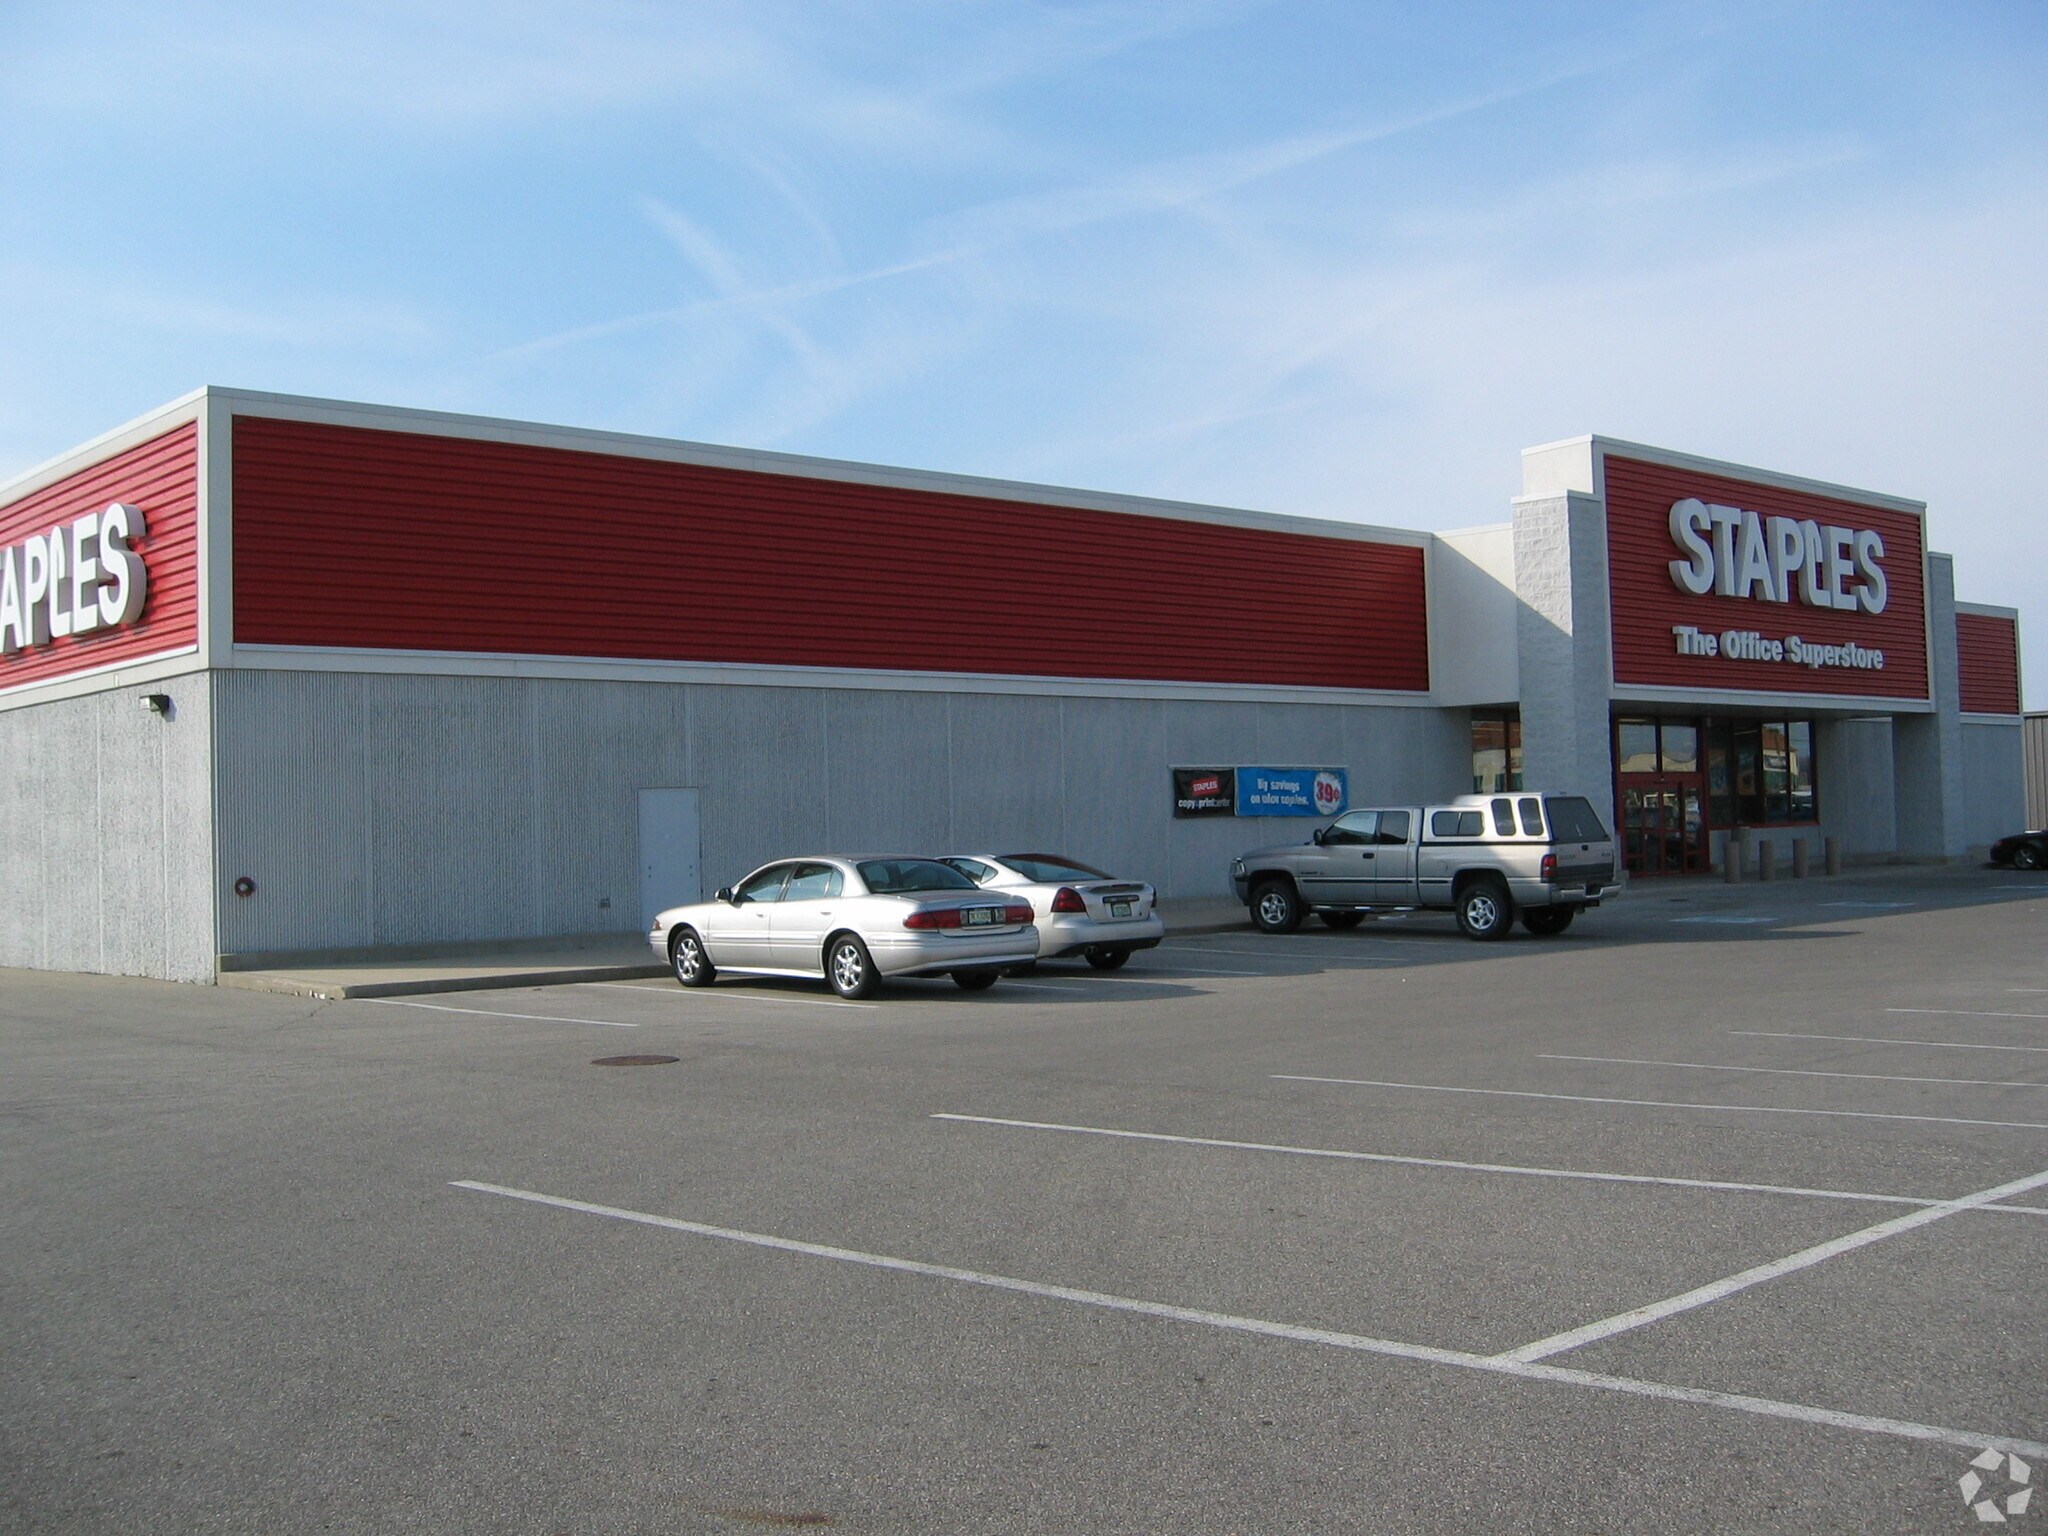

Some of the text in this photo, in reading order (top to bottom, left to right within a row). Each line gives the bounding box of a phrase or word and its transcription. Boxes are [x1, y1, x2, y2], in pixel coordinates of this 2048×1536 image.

[0, 503, 146, 651] APLES
[1668, 498, 1887, 614] STAPLES
[1672, 626, 1883, 669] The Office Superstore
[1193, 780, 1218, 792] STAPLES
[1270, 780, 1300, 793] savings
